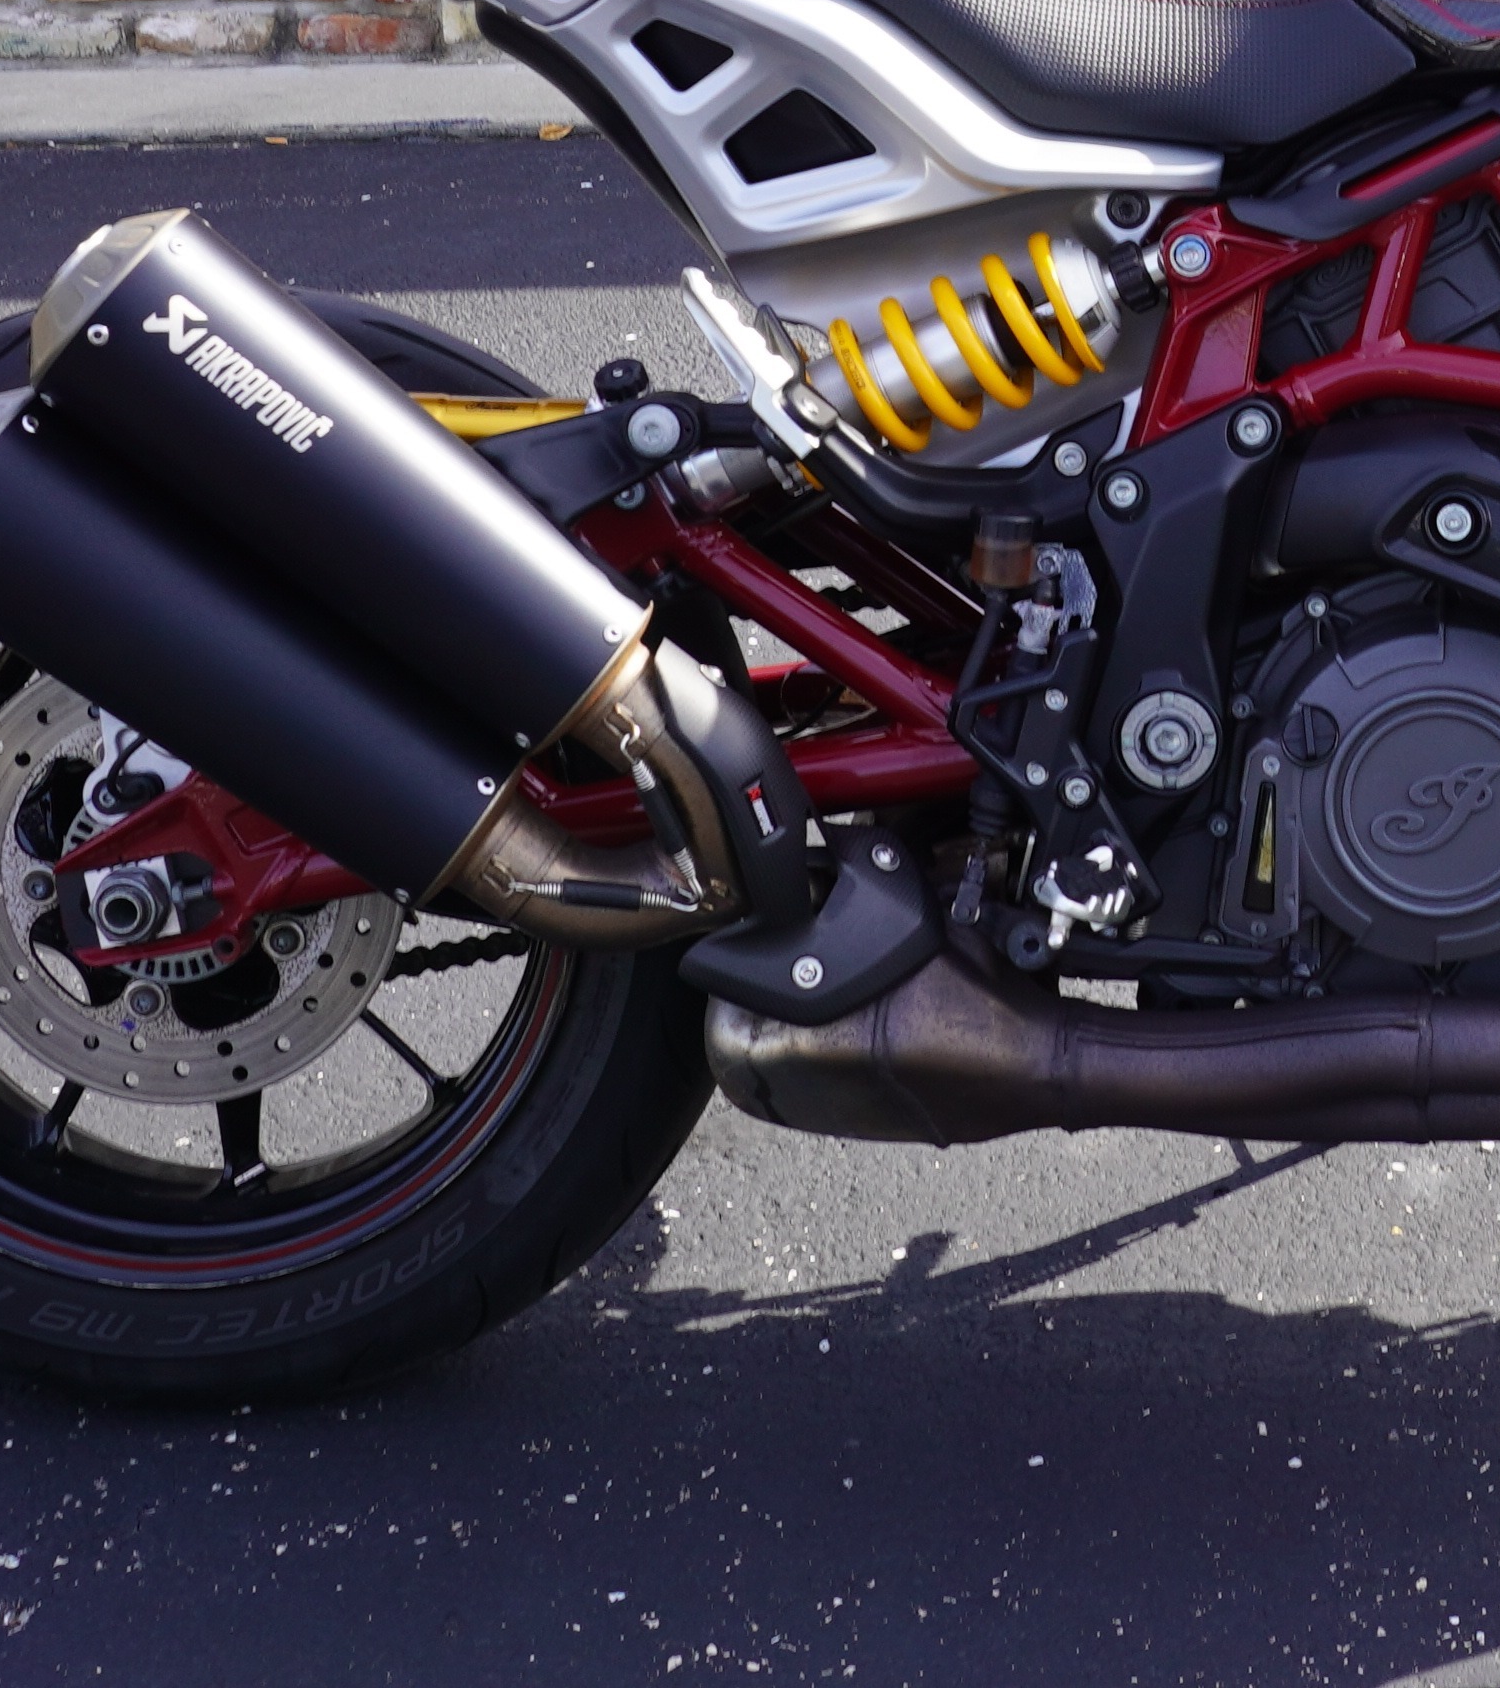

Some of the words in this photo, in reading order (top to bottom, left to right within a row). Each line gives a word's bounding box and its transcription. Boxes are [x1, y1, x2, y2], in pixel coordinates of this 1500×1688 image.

[184, 334, 335, 454] AKRAPOVIČ
[26, 1292, 136, 1343] M9
[152, 1195, 488, 1344] SPORTEC
